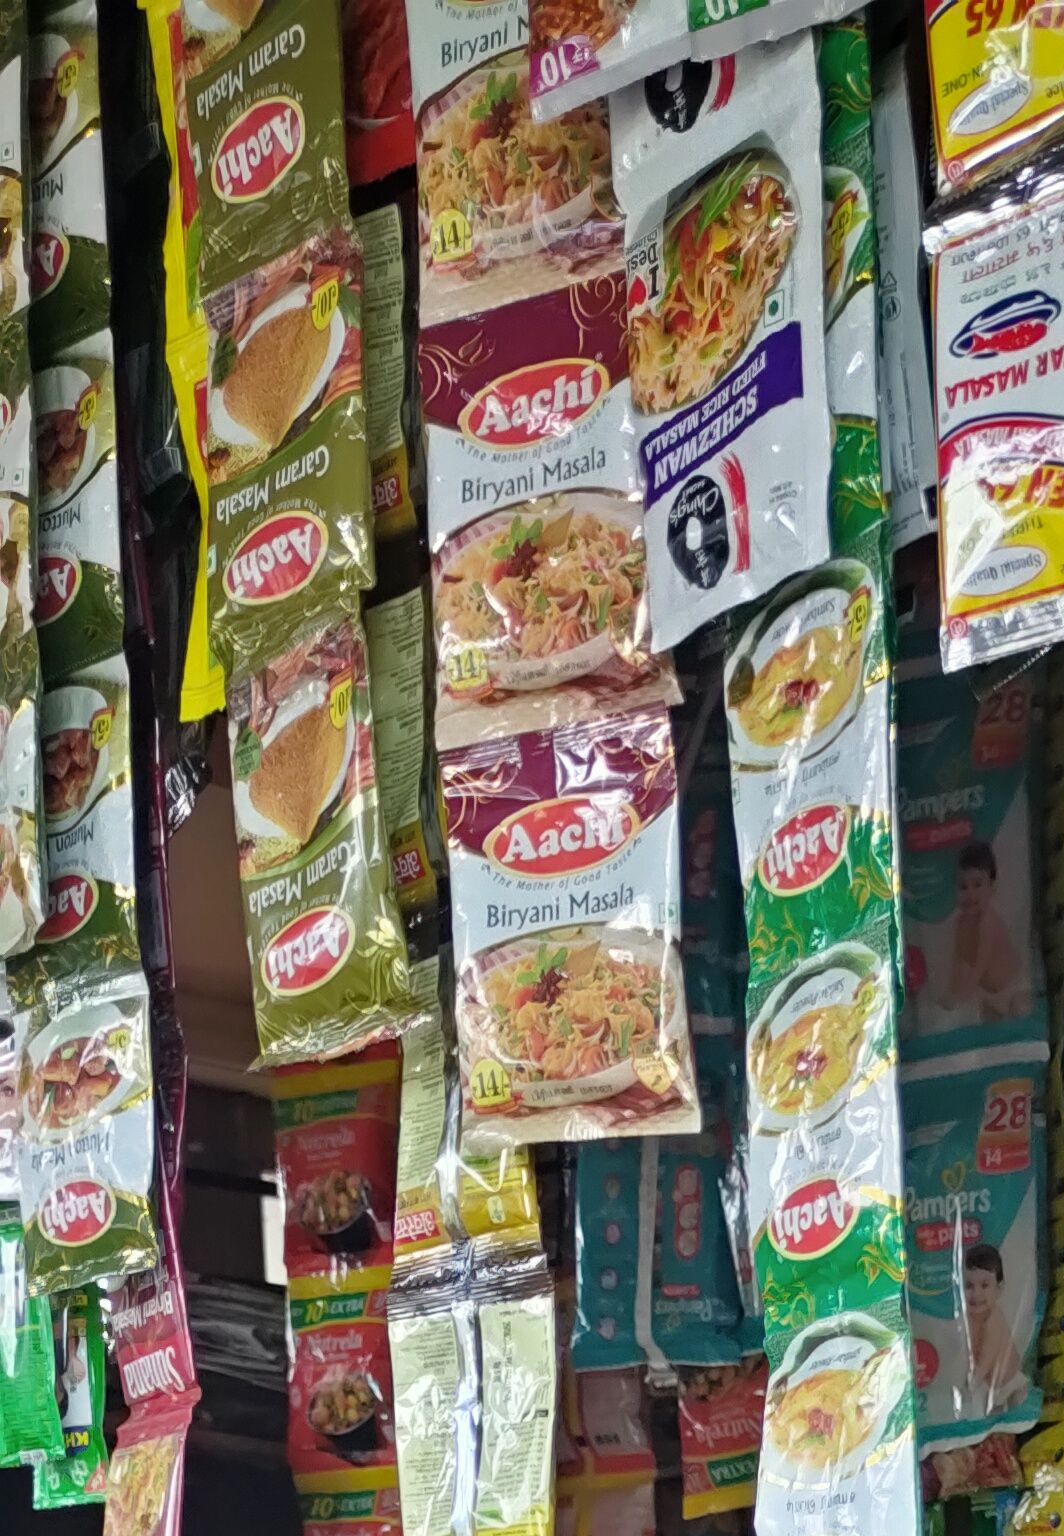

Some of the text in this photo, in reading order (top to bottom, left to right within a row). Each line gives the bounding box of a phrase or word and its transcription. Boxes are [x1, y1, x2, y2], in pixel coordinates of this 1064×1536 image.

[441, 22, 508, 67] Biryani
[196, 25, 305, 119] Garam Masala
[218, 108, 293, 199] Aachi
[626, 242, 659, 273] Desi
[476, 366, 597, 437] Aachi
[645, 350, 767, 463] FRIED RICE MASALA
[944, 360, 1030, 410] MASALA
[651, 384, 758, 489] SCHEZWAN
[216, 445, 330, 522] Garam Masala
[461, 450, 607, 504] Biryani Masala
[669, 487, 720, 528] Ching's
[230, 522, 314, 601] Aachi
[1000, 554, 1042, 579] Special
[500, 804, 628, 863] Aachi
[766, 811, 843, 890] Aachi
[247, 870, 303, 917] Masala
[486, 886, 634, 931] Biryani Masala
[265, 918, 344, 988] Aachi
[983, 1095, 1029, 1132] 28
[43, 1189, 106, 1236] Aachi
[774, 1191, 848, 1252] Aachi
[904, 1187, 991, 1222] Pampers
[124, 1345, 184, 1399] Suhana
[711, 1459, 755, 1485] EXTRA
